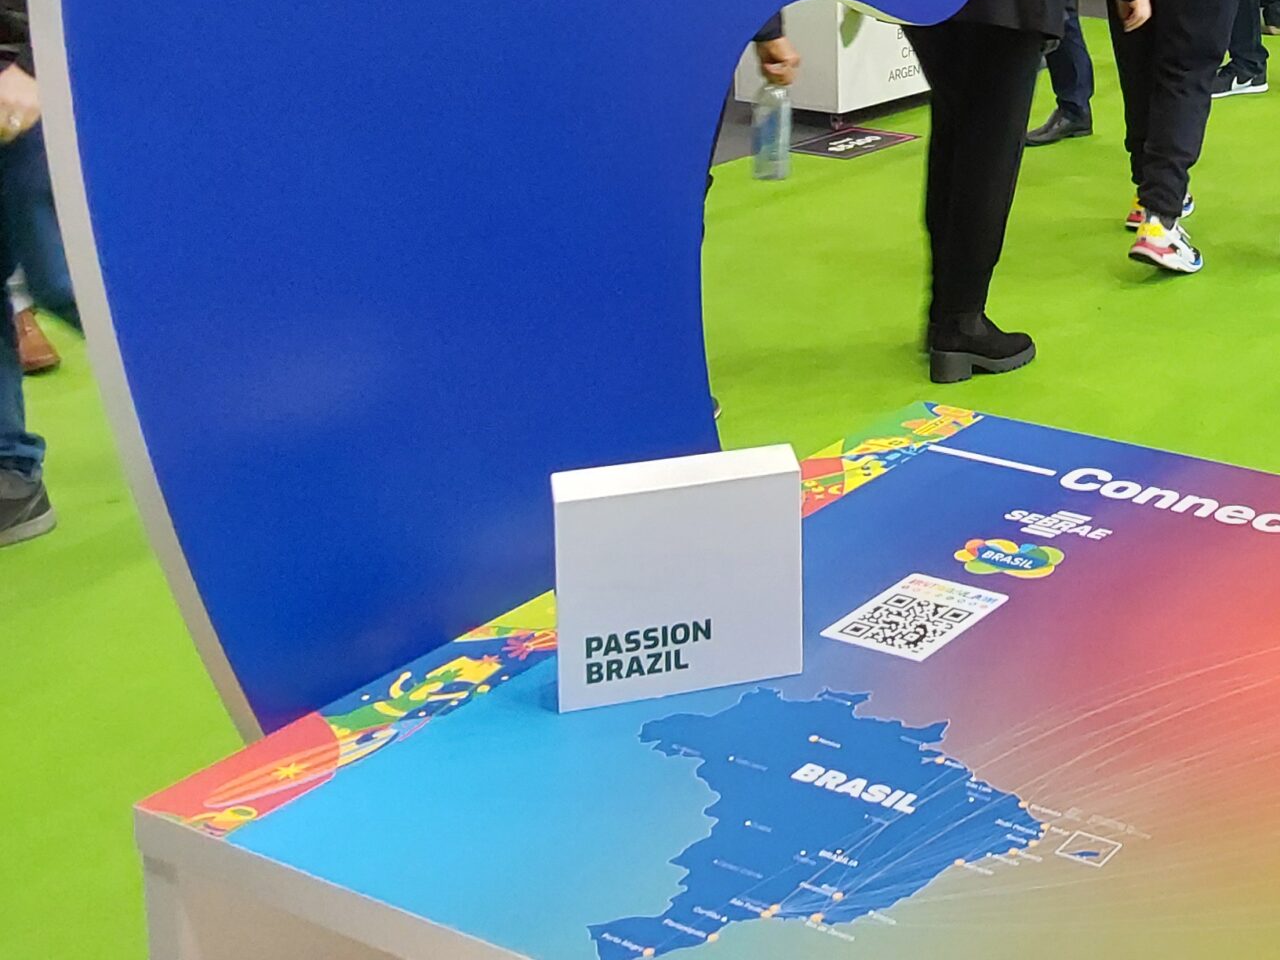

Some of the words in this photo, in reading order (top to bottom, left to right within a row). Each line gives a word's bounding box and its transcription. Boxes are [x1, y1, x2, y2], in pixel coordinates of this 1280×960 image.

[1004, 509, 1112, 541] SEBRAE
[981, 549, 1035, 570] BRASIL
[585, 618, 712, 659] PASSION
[585, 648, 689, 685] BRAZIL
[790, 762, 918, 815] BRASIL
